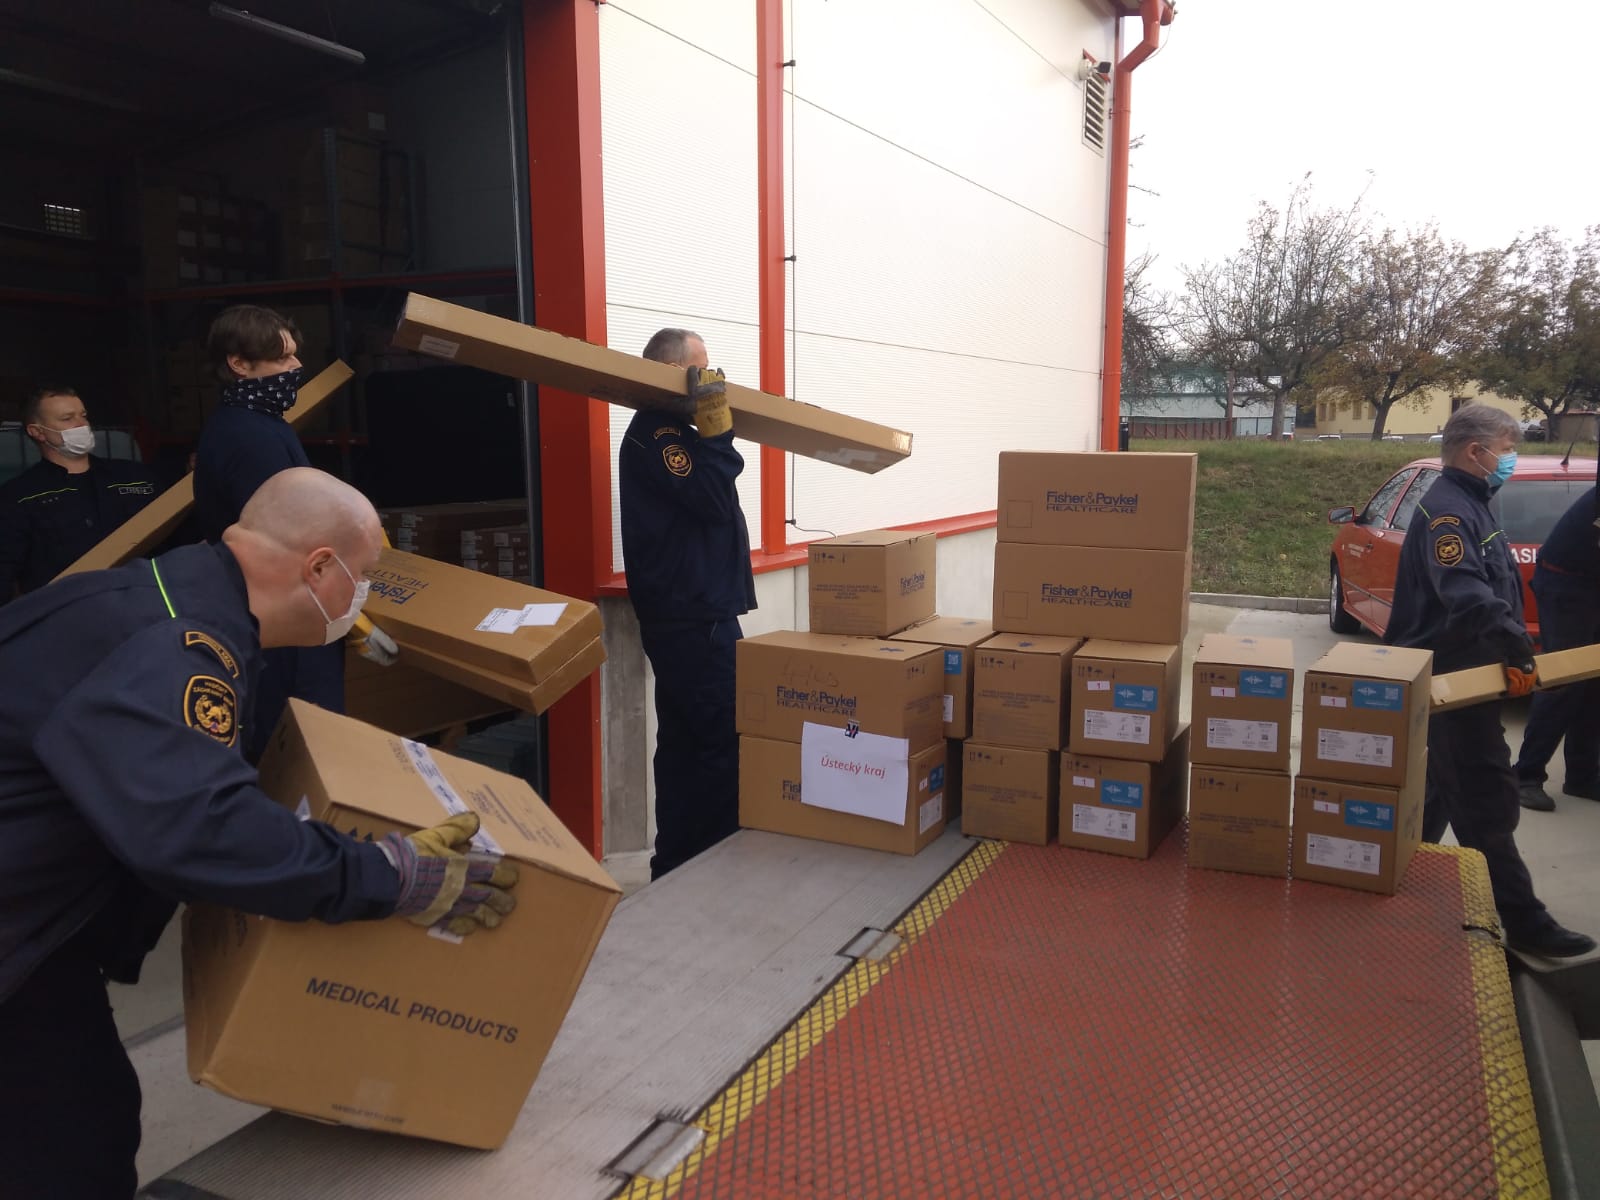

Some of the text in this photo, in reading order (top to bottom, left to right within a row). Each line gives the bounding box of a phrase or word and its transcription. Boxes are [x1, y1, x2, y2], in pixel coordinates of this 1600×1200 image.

[1046, 503, 1137, 514] HEALTHCARE
[1041, 597, 1132, 609] HEALTHCARE
[821, 754, 886, 779] Ústecký kraj
[306, 977, 519, 1044] MEDICAL PRODUCTS
